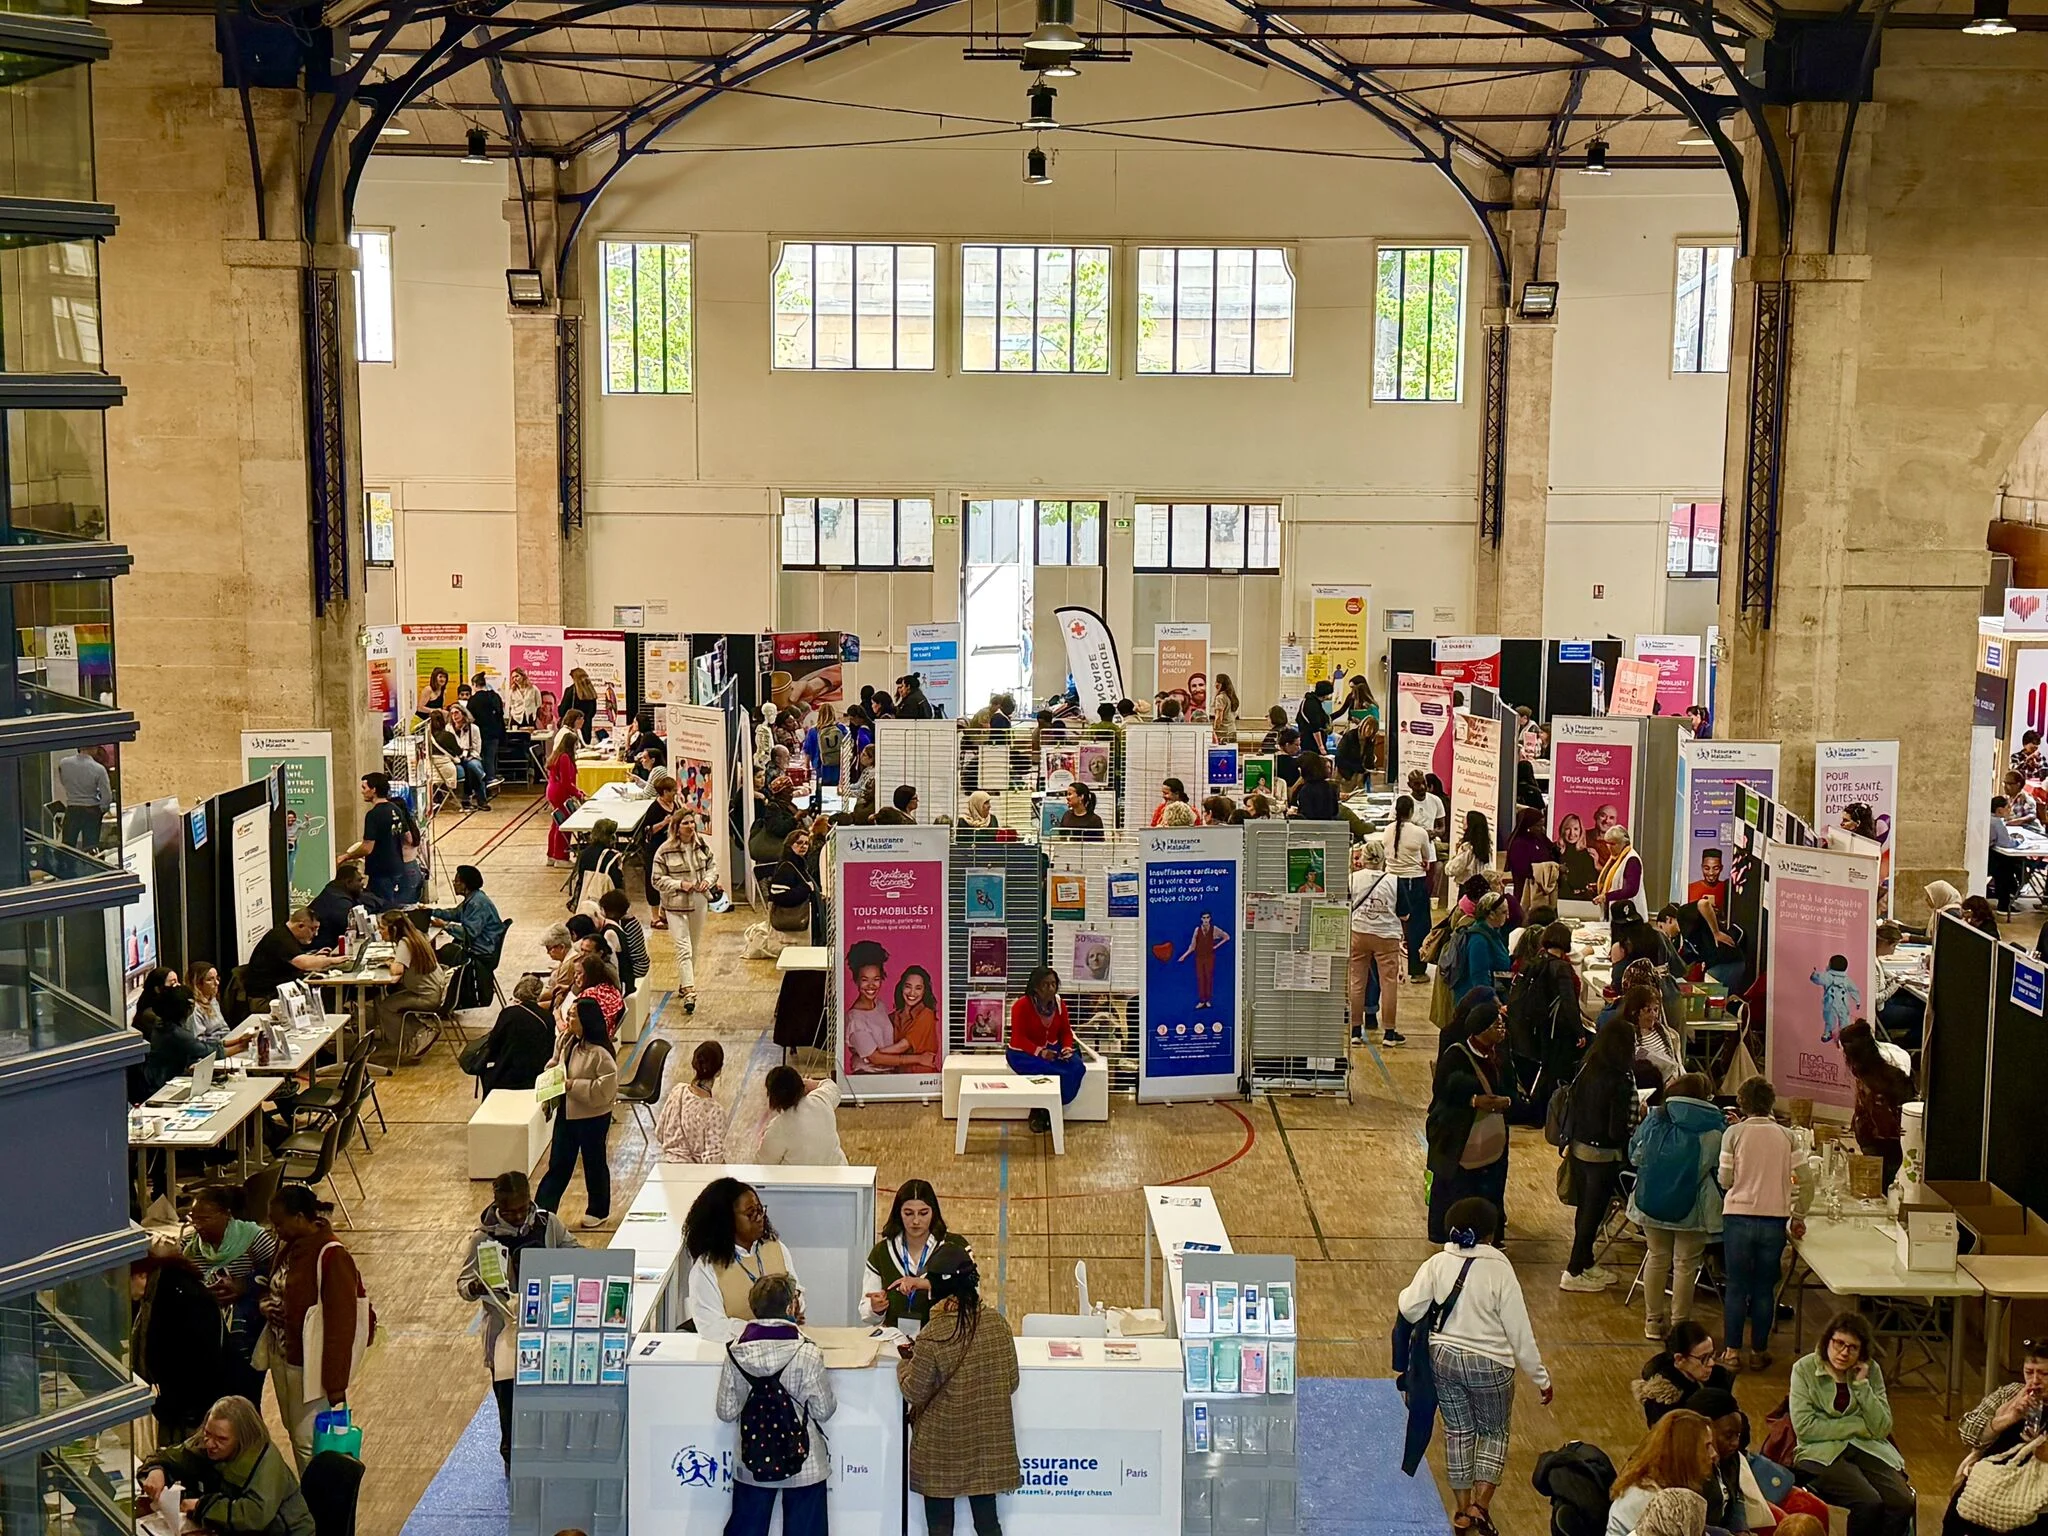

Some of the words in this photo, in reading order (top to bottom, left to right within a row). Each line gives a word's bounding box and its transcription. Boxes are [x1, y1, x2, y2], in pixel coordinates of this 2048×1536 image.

[1455, 752, 1477, 765] Ensemble
[1478, 758, 1494, 769] contre
[1562, 776, 1581, 784] TOUS
[1582, 776, 1620, 786] MOBILISÉS
[1826, 772, 1849, 781] POUR
[1826, 783, 1853, 792] VOTRE
[1855, 781, 1884, 792] SANTÉ,
[1826, 793, 1879, 803] FAITES-VOUS
[1791, 862, 1818, 870] l'Assurance
[1150, 868, 1192, 876] Insuffisance
[1194, 868, 1229, 876] cardiaque.
[1150, 895, 1176, 903] quelque
[1781, 890, 1807, 901] Partez
[1808, 893, 1813, 902] à
[1815, 895, 1823, 903] la
[1824, 896, 1863, 909] conquête
[853, 907, 877, 916] TOUS
[880, 905, 928, 916] MOBILISÉS
[930, 907, 934, 915] !
[1780, 901, 1799, 910] d'un
[1800, 904, 1827, 914] nouvel
[1829, 908, 1858, 918] espace
[1779, 911, 1799, 920] pour
[1801, 914, 1822, 923] votre
[1022, 1457, 1098, 1470] ssurance
[847, 1464, 868, 1475] Paris
[1126, 1468, 1148, 1478] Paris
[1020, 1470, 1069, 1486] ladie
[1018, 1488, 1054, 1496] ensemble,
[1055, 1488, 1085, 1497] protéger
